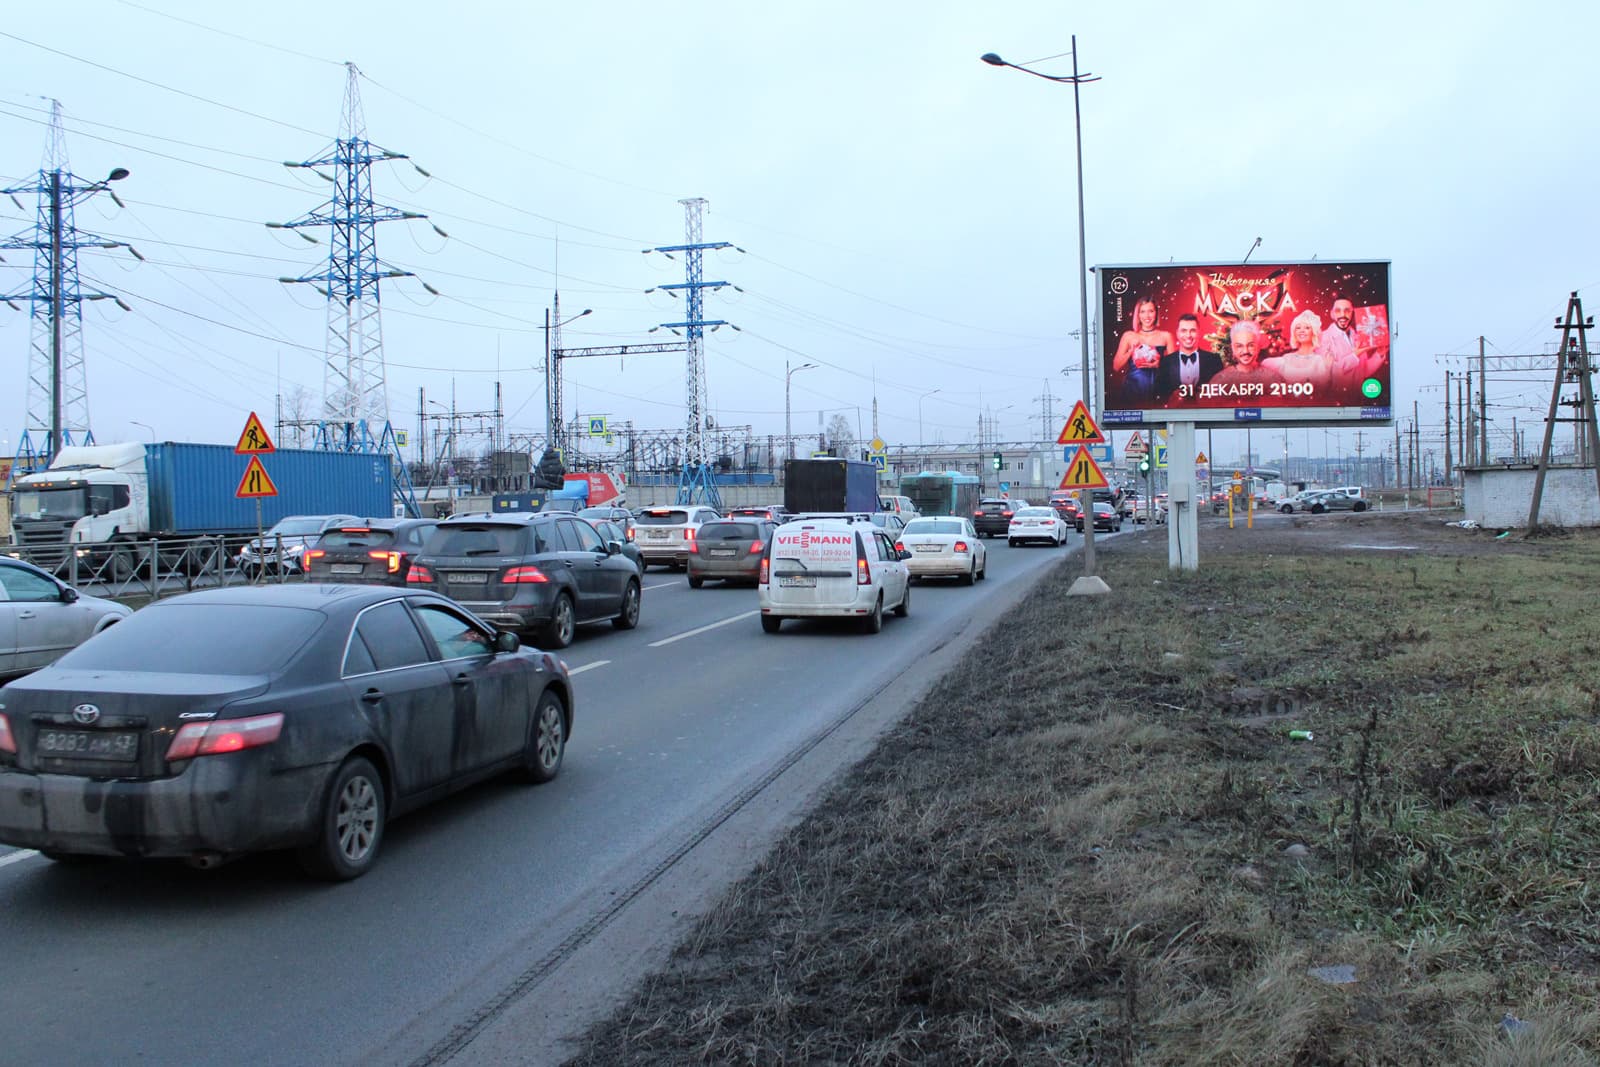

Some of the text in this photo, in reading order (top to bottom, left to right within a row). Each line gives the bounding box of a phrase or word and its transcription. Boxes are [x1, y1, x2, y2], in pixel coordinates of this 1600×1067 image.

[1113, 281, 1127, 290] 12+
[1209, 273, 1276, 293] Новогодняя
[1194, 290, 1297, 313] МАСКА
[1179, 382, 1314, 398] 31 ДЕКАБРЯ 21:00
[778, 532, 851, 548] VIESSMANN
